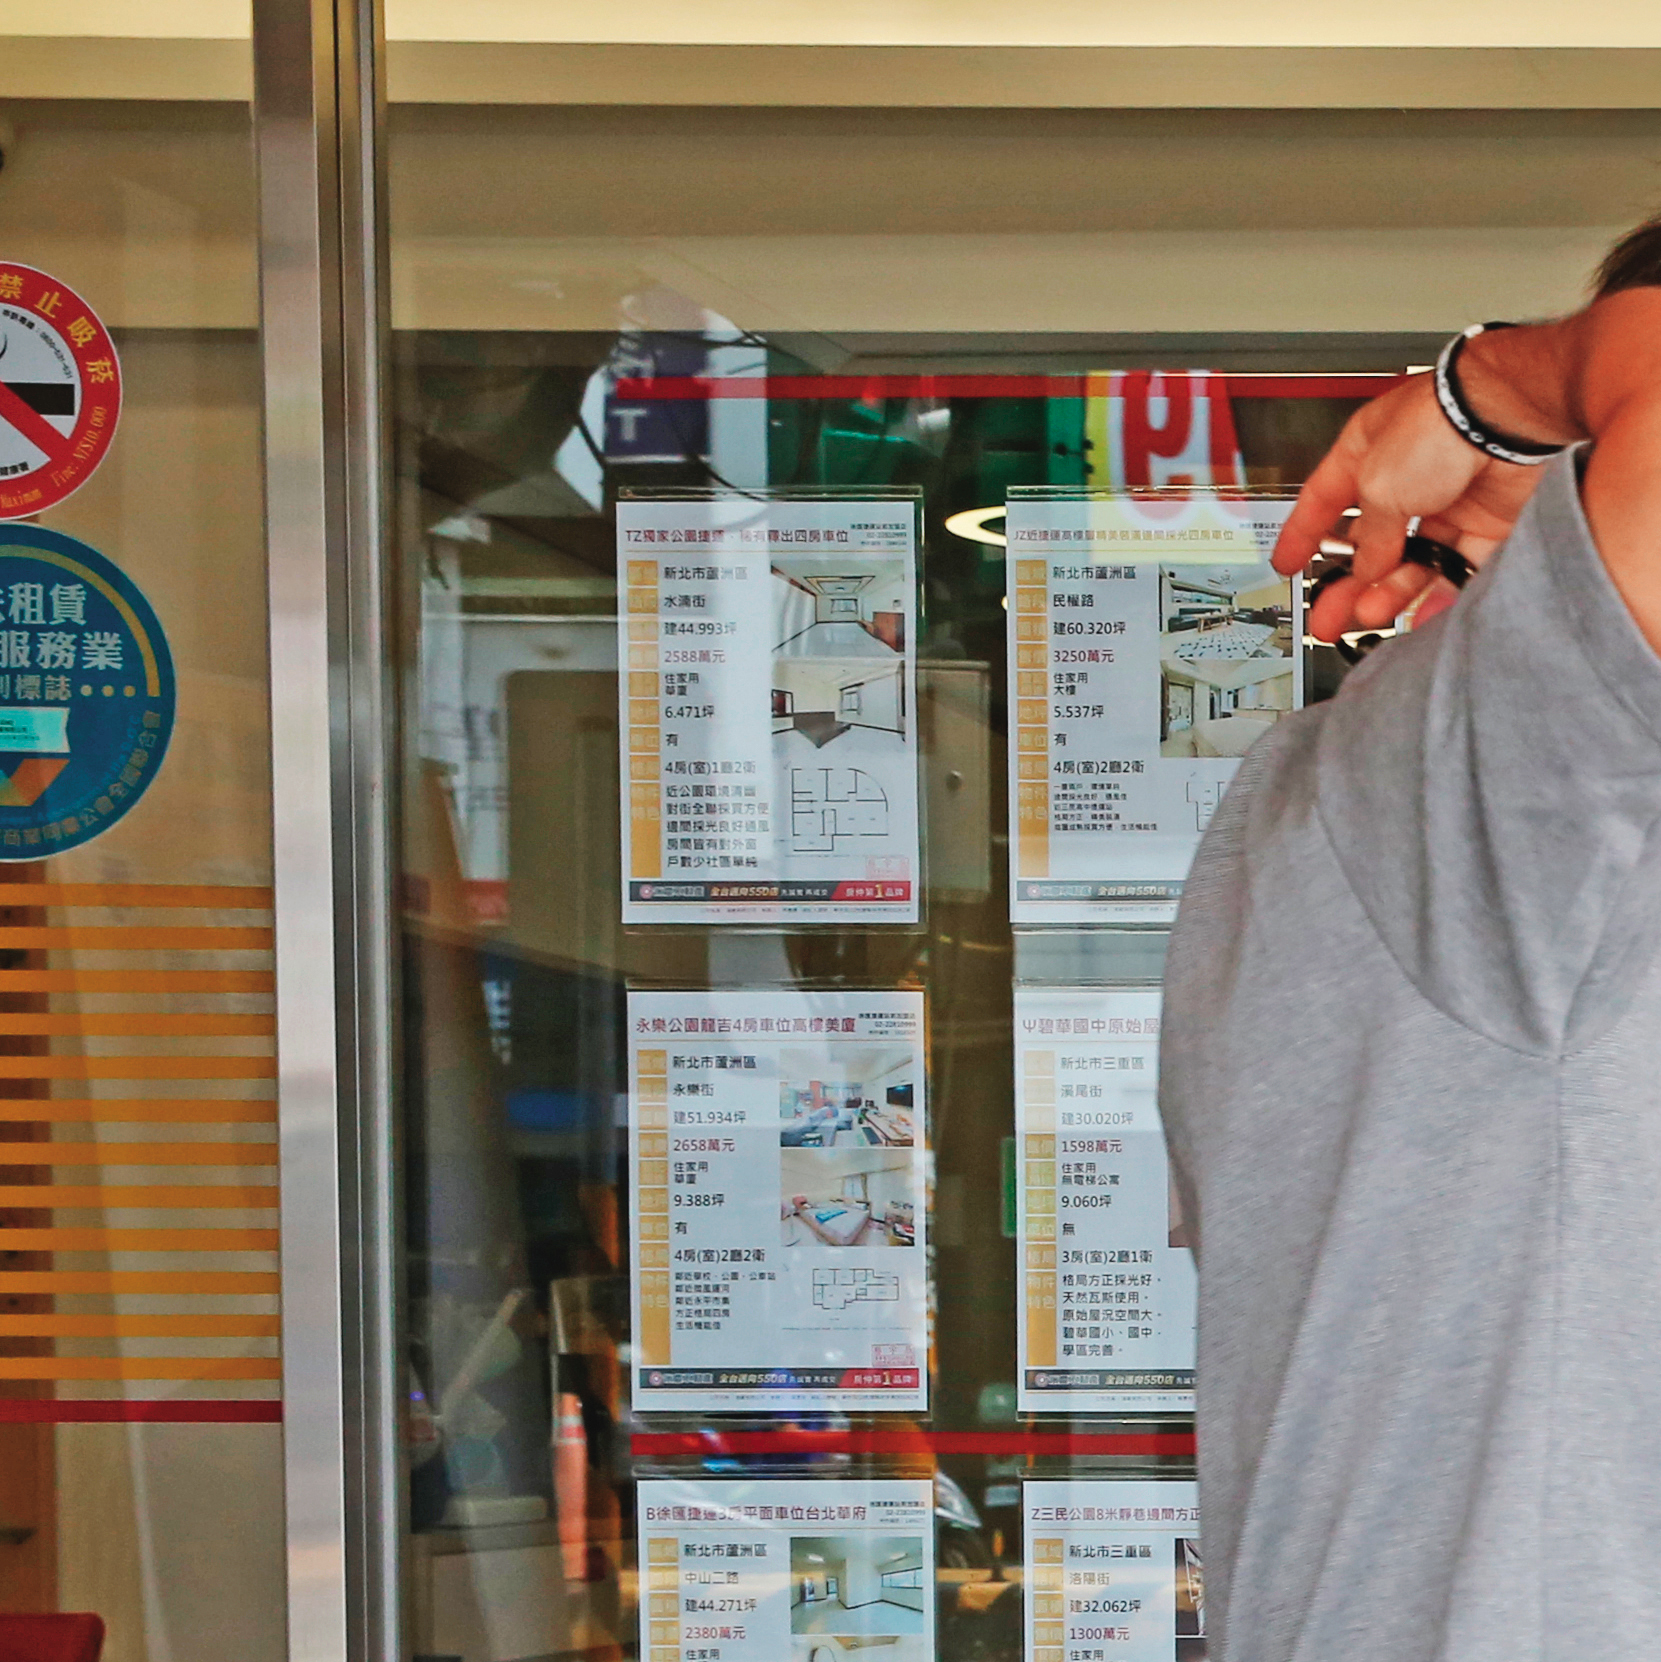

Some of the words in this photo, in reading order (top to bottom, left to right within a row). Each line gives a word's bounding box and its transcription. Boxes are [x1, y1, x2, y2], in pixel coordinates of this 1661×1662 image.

[1053, 594, 1094, 607] 民權路
[1053, 621, 1126, 636] 建60.320坪
[664, 649, 726, 663] 2588萬元
[1053, 649, 1114, 663] 3250萬元
[1023, 1018, 1159, 1033] Ψ碧華國中原始屋
[1060, 1085, 1102, 1098] 溪尾街
[673, 1138, 735, 1152] 2658萬元
[1061, 1139, 1122, 1153] 1598萬元
[1031, 1507, 1201, 1521] Z三民公園8米靜巷邊間方正
[1069, 1572, 1110, 1586] 洛陽街
[1070, 1627, 1130, 1641] 1300萬元
